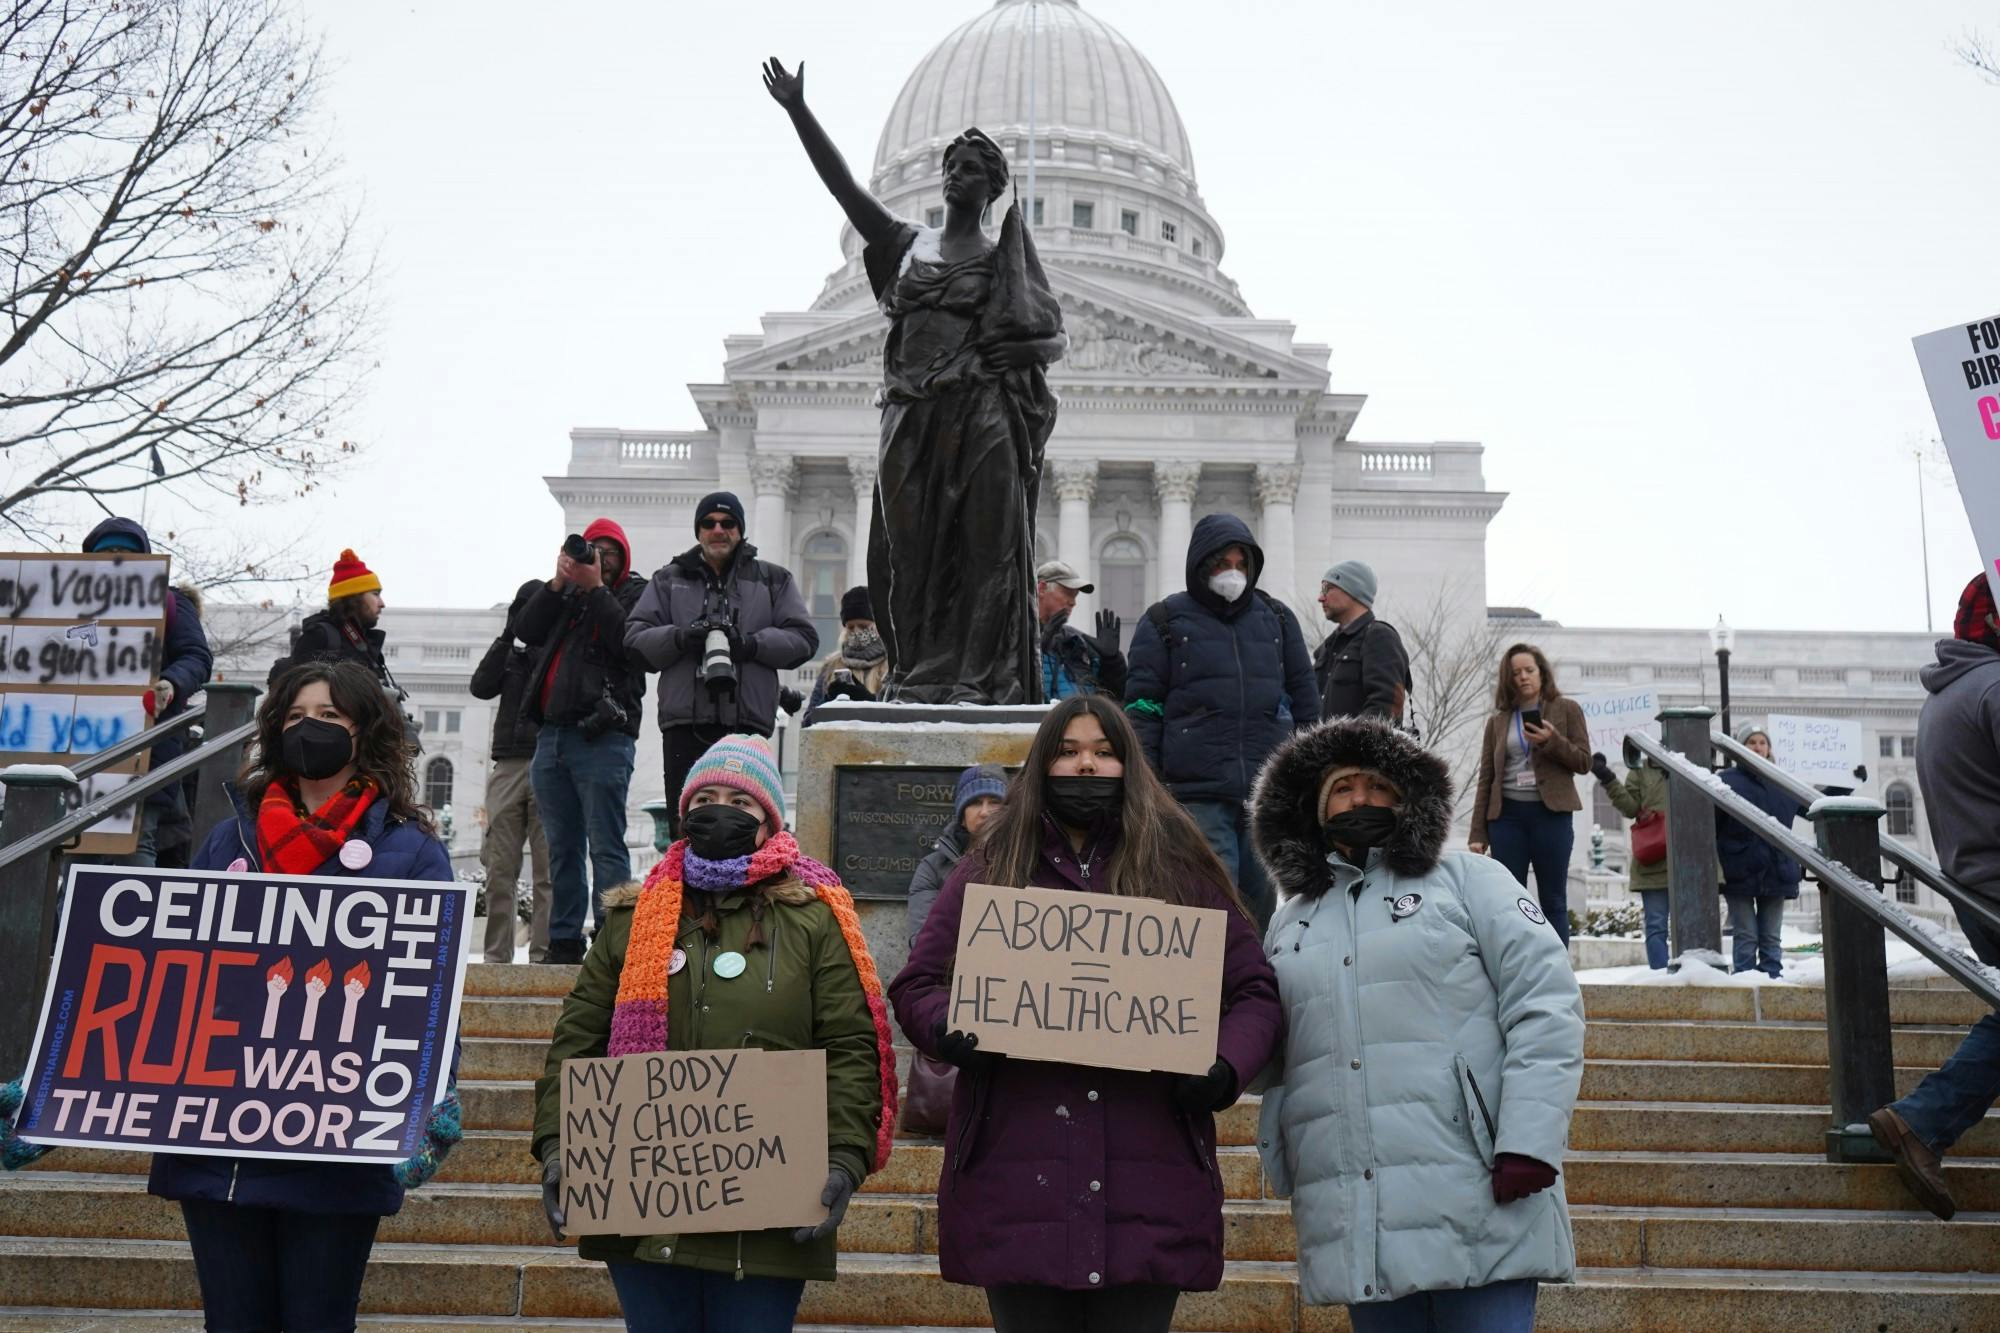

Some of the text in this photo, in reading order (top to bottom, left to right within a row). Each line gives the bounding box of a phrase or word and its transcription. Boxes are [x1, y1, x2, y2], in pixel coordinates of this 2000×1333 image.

[51, 557, 168, 618] Vagina
[39, 640, 98, 683] gun
[1603, 694, 1651, 715] CHOICE
[52, 713, 121, 752] you
[1803, 738, 1847, 752] HEALTH
[1801, 760, 1849, 770] CHOICE
[99, 879, 389, 950] CEILING
[443, 893, 456, 922] 2023
[967, 899, 1202, 959] ABORTION
[436, 946, 448, 968] JAN
[442, 925, 452, 946] 22,
[62, 943, 259, 1088] ROE
[352, 893, 441, 1151] NOT THE
[432, 983, 444, 1028] MARCH
[952, 975, 1200, 1035] HEALTHCARE
[27, 990, 75, 1130] BIGGERTHANROE.COM
[243, 1046, 362, 1094] WAS
[416, 1031, 436, 1090] WOMEN'S
[568, 1053, 738, 1105] MY BODY
[52, 1088, 353, 1149] THE FLOOR
[404, 1091, 425, 1152] NATIONAL
[566, 1103, 754, 1145] MY CHOICE
[565, 1135, 787, 1180] MY FREEDOM
[563, 1176, 745, 1227] MY VOICE
